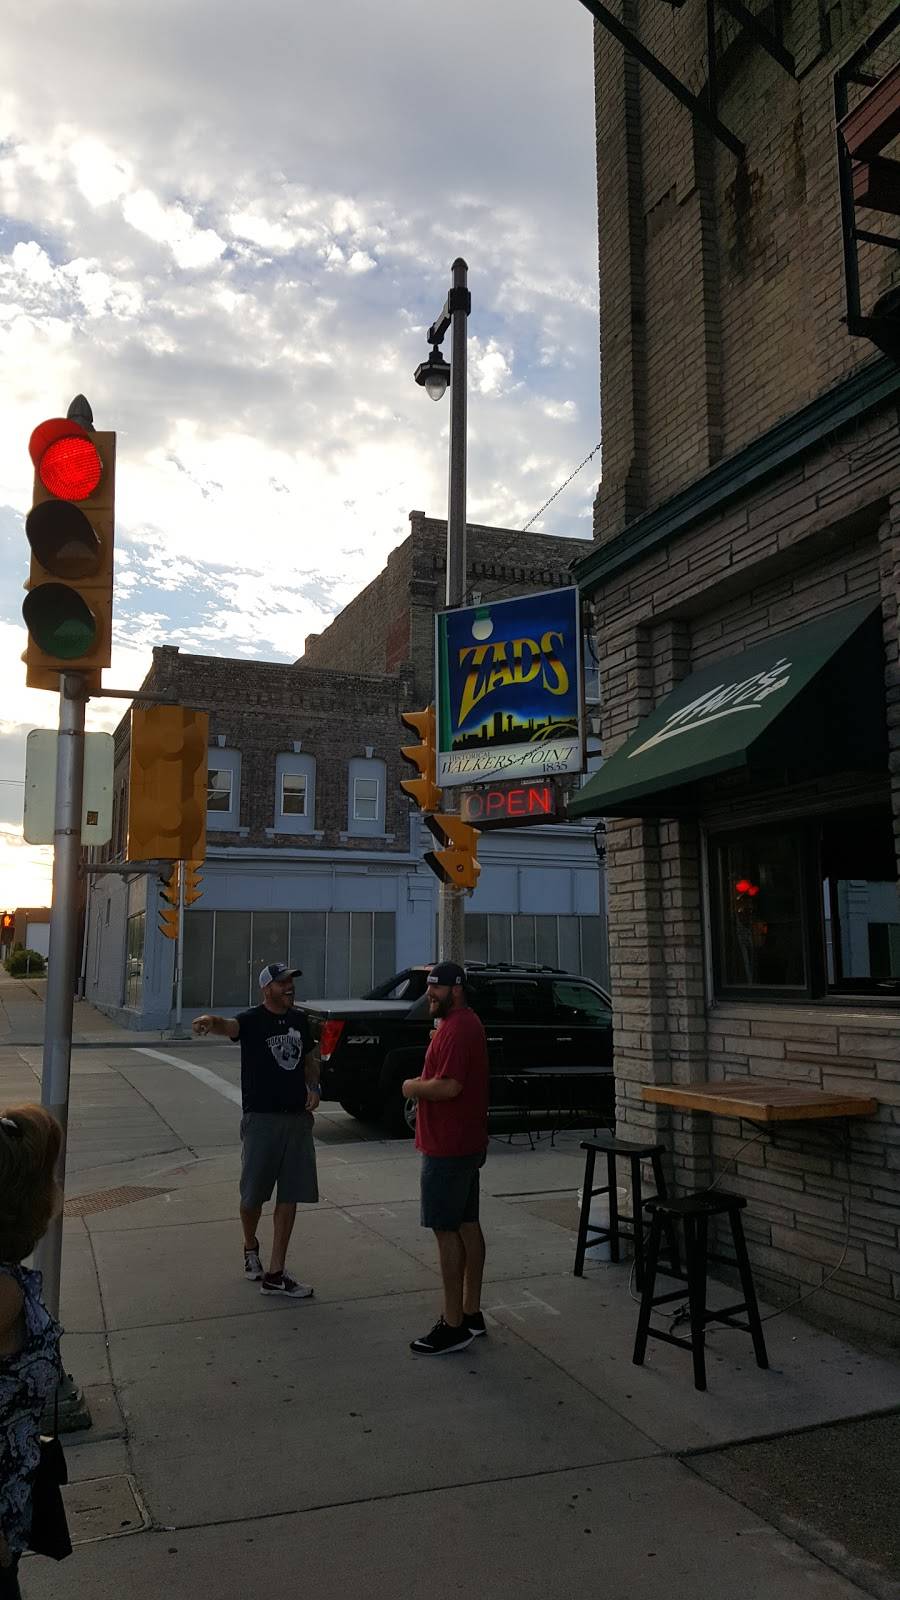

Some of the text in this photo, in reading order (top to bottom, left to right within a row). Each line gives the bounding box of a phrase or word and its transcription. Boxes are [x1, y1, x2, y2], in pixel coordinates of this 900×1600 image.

[458, 631, 570, 728] ZADS
[449, 751, 491, 763] HISTORICAL
[519, 746, 578, 766] POINT
[542, 761, 568, 773] 1835
[467, 787, 550, 816] OPEN
